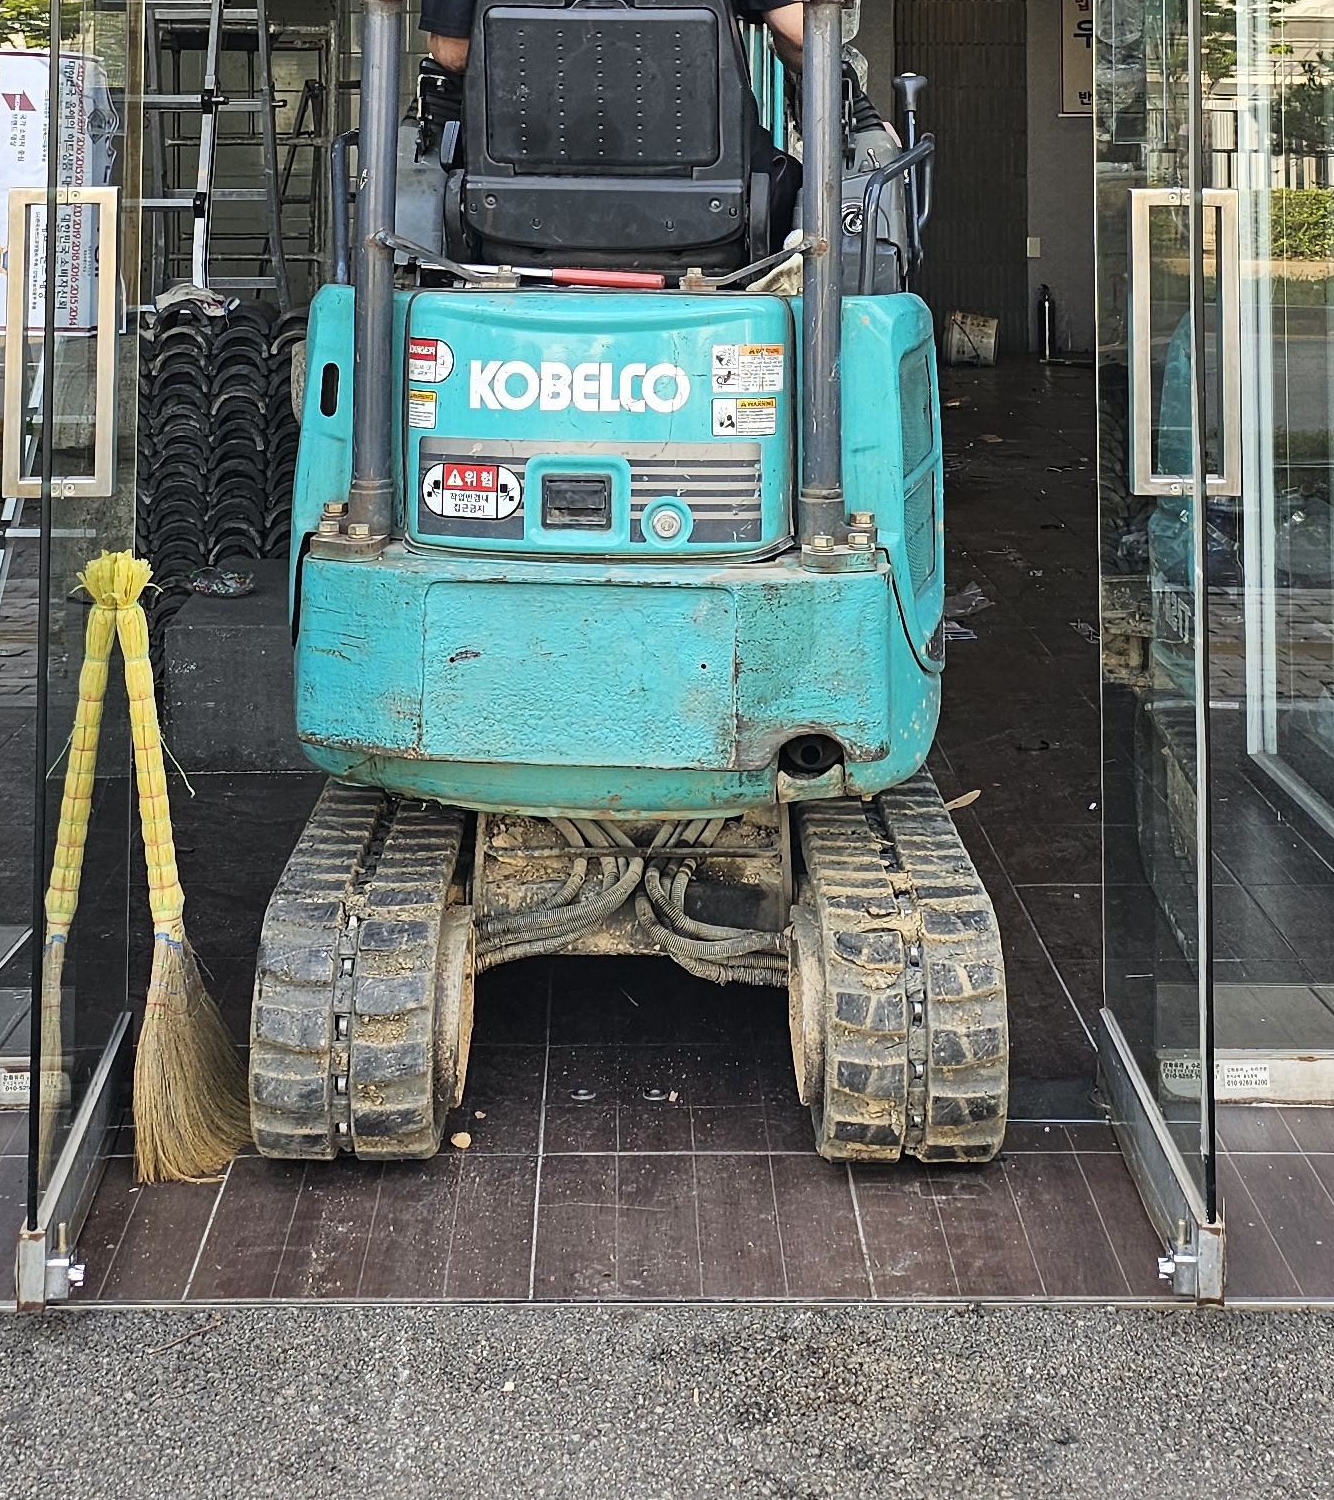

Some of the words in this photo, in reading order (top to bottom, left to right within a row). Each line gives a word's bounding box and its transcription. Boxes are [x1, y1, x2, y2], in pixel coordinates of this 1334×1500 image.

[56, 214, 71, 254] 대한민국
[73, 219, 81, 239] 2019
[72, 241, 80, 261] 2018
[71, 263, 79, 282] 2016
[70, 284, 79, 304] 2015
[69, 306, 78, 326] 2014
[469, 359, 691, 414] KOBELCO
[464, 470, 494, 488] 위험
